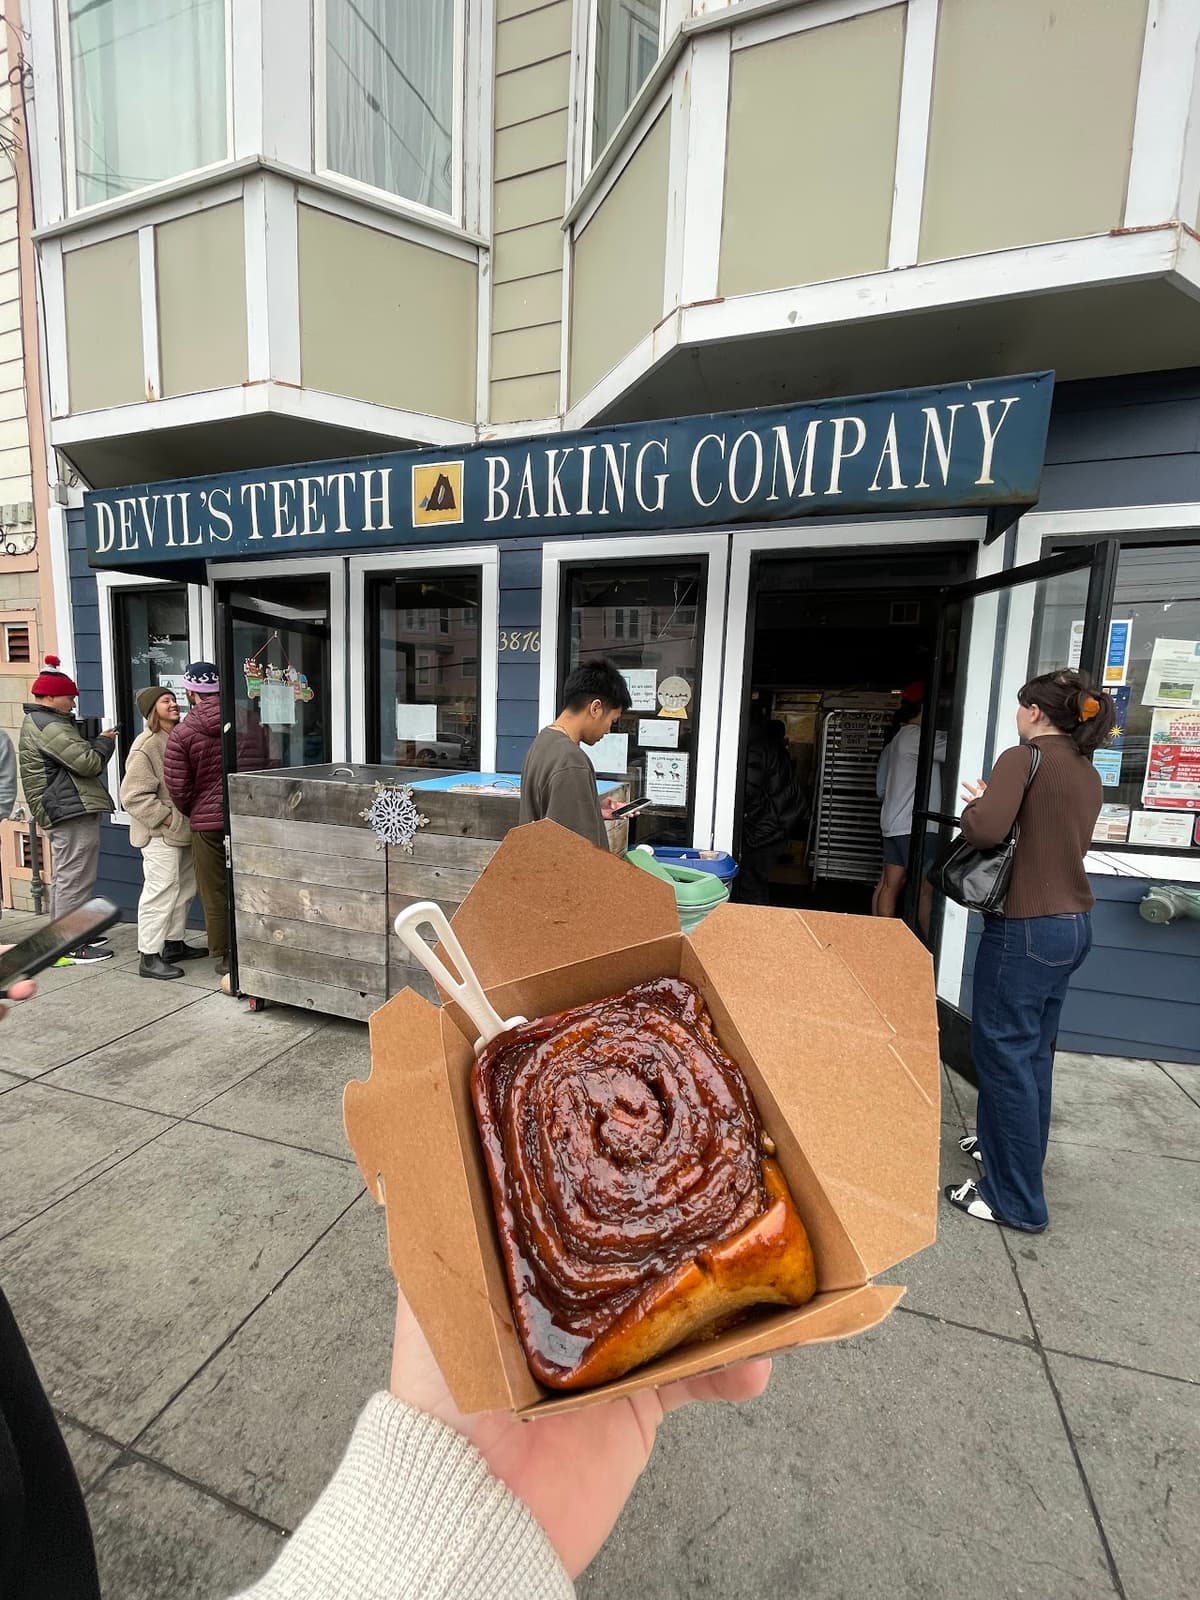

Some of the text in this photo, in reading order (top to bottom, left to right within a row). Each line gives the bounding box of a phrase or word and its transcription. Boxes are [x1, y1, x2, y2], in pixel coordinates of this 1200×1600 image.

[92, 397, 1021, 553] DEVIL'S TEETH BAKING COMPANY
[498, 631, 541, 652] 3876
